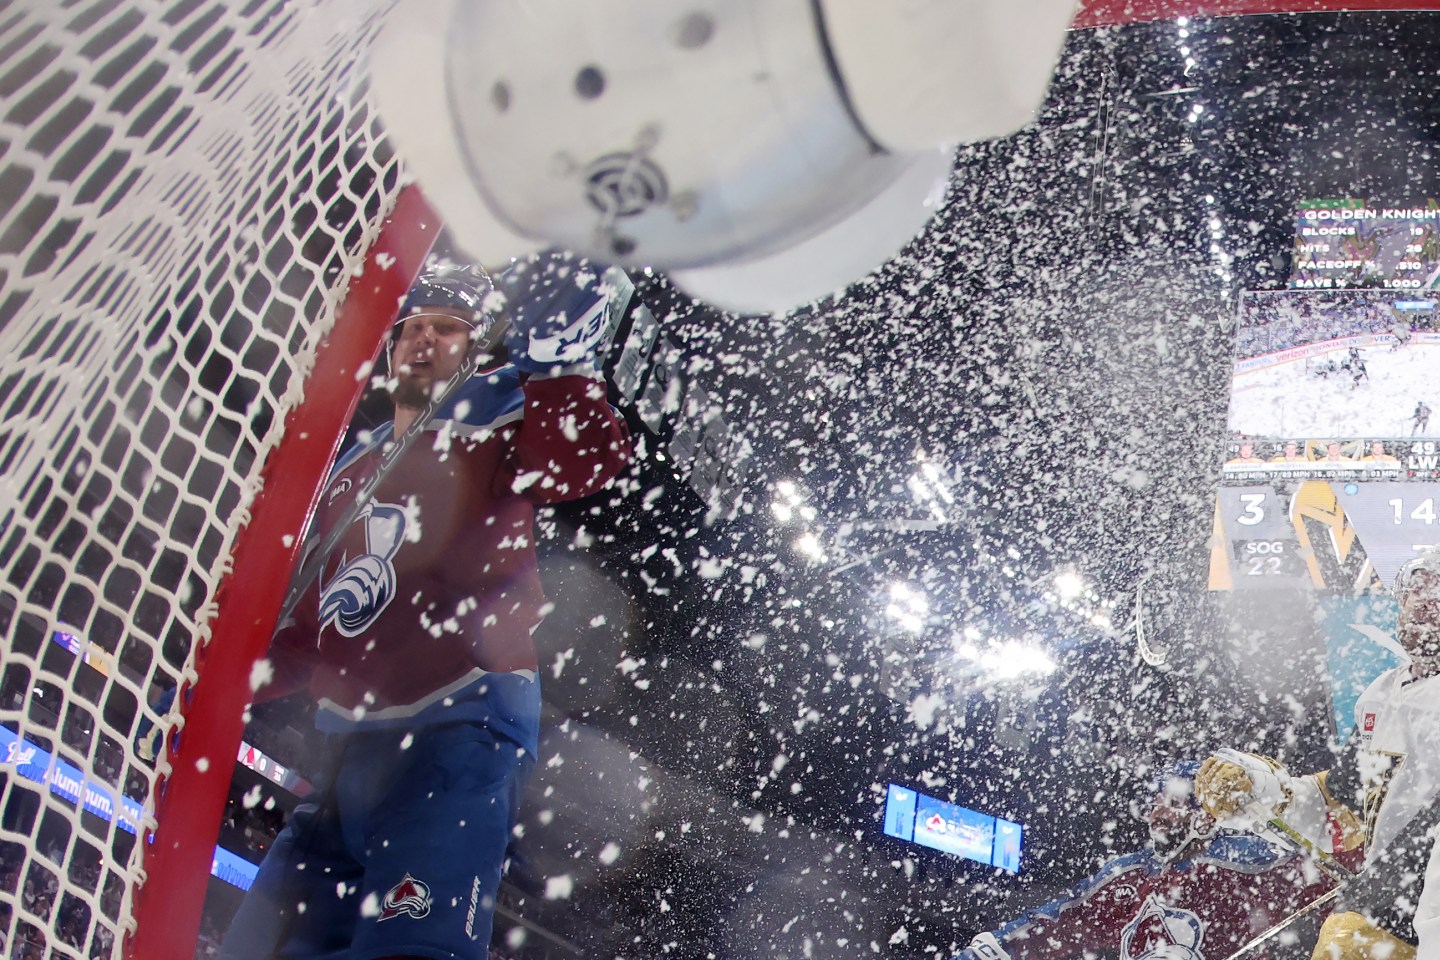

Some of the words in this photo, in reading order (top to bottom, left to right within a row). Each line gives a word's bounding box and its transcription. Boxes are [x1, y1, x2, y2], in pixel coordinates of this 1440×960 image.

[1305, 209, 1377, 220] GOLDEN
[1302, 227, 1356, 236] BLOCKS
[1409, 227, 1424, 236] 19
[1300, 244, 1330, 252] HITS
[1405, 244, 1422, 253] 26
[1298, 260, 1361, 269] FACEOFF
[1365, 260, 1376, 268] %
[1296, 279, 1332, 288] SAVE
[1335, 279, 1347, 287] %
[1383, 279, 1421, 288] 1.000
[1275, 349, 1309, 363] verizon
[1410, 442, 1435, 455] 49
[1408, 456, 1438, 469] LW
[1237, 494, 1266, 526] 3
[1246, 541, 1284, 555] SOG
[1248, 557, 1282, 576] 22
[259, 758, 267, 772] 0
[42, 767, 113, 815] Aluminum.
[465, 875, 481, 939] BAUER
